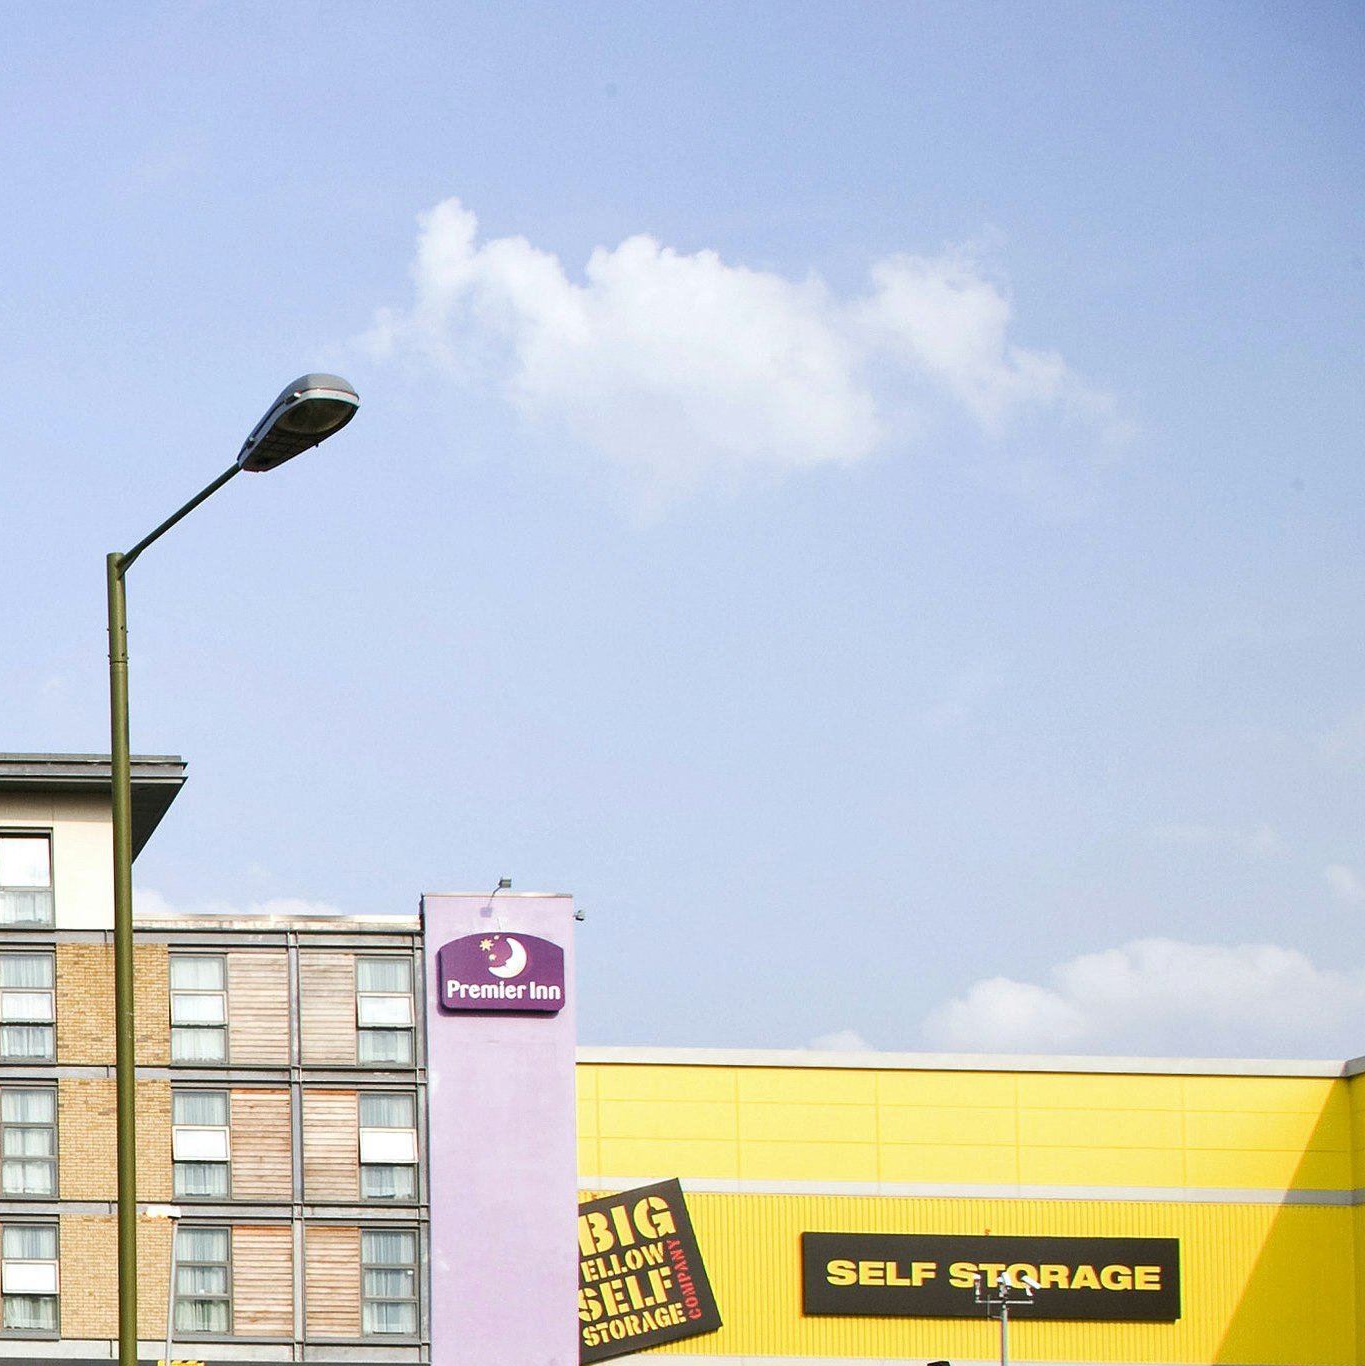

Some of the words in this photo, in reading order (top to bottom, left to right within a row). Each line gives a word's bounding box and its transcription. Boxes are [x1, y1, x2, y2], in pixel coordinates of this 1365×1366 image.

[446, 980, 527, 999] Premier
[529, 981, 561, 1000] Inn
[578, 1195, 677, 1257] BIG
[580, 1241, 665, 1283] ELLOW
[667, 1239, 703, 1321] COMPANY
[825, 1259, 937, 1287] SELF
[948, 1261, 1162, 1291] STORAGE
[578, 1265, 673, 1322] SELF
[581, 1302, 688, 1347] STORAGE
